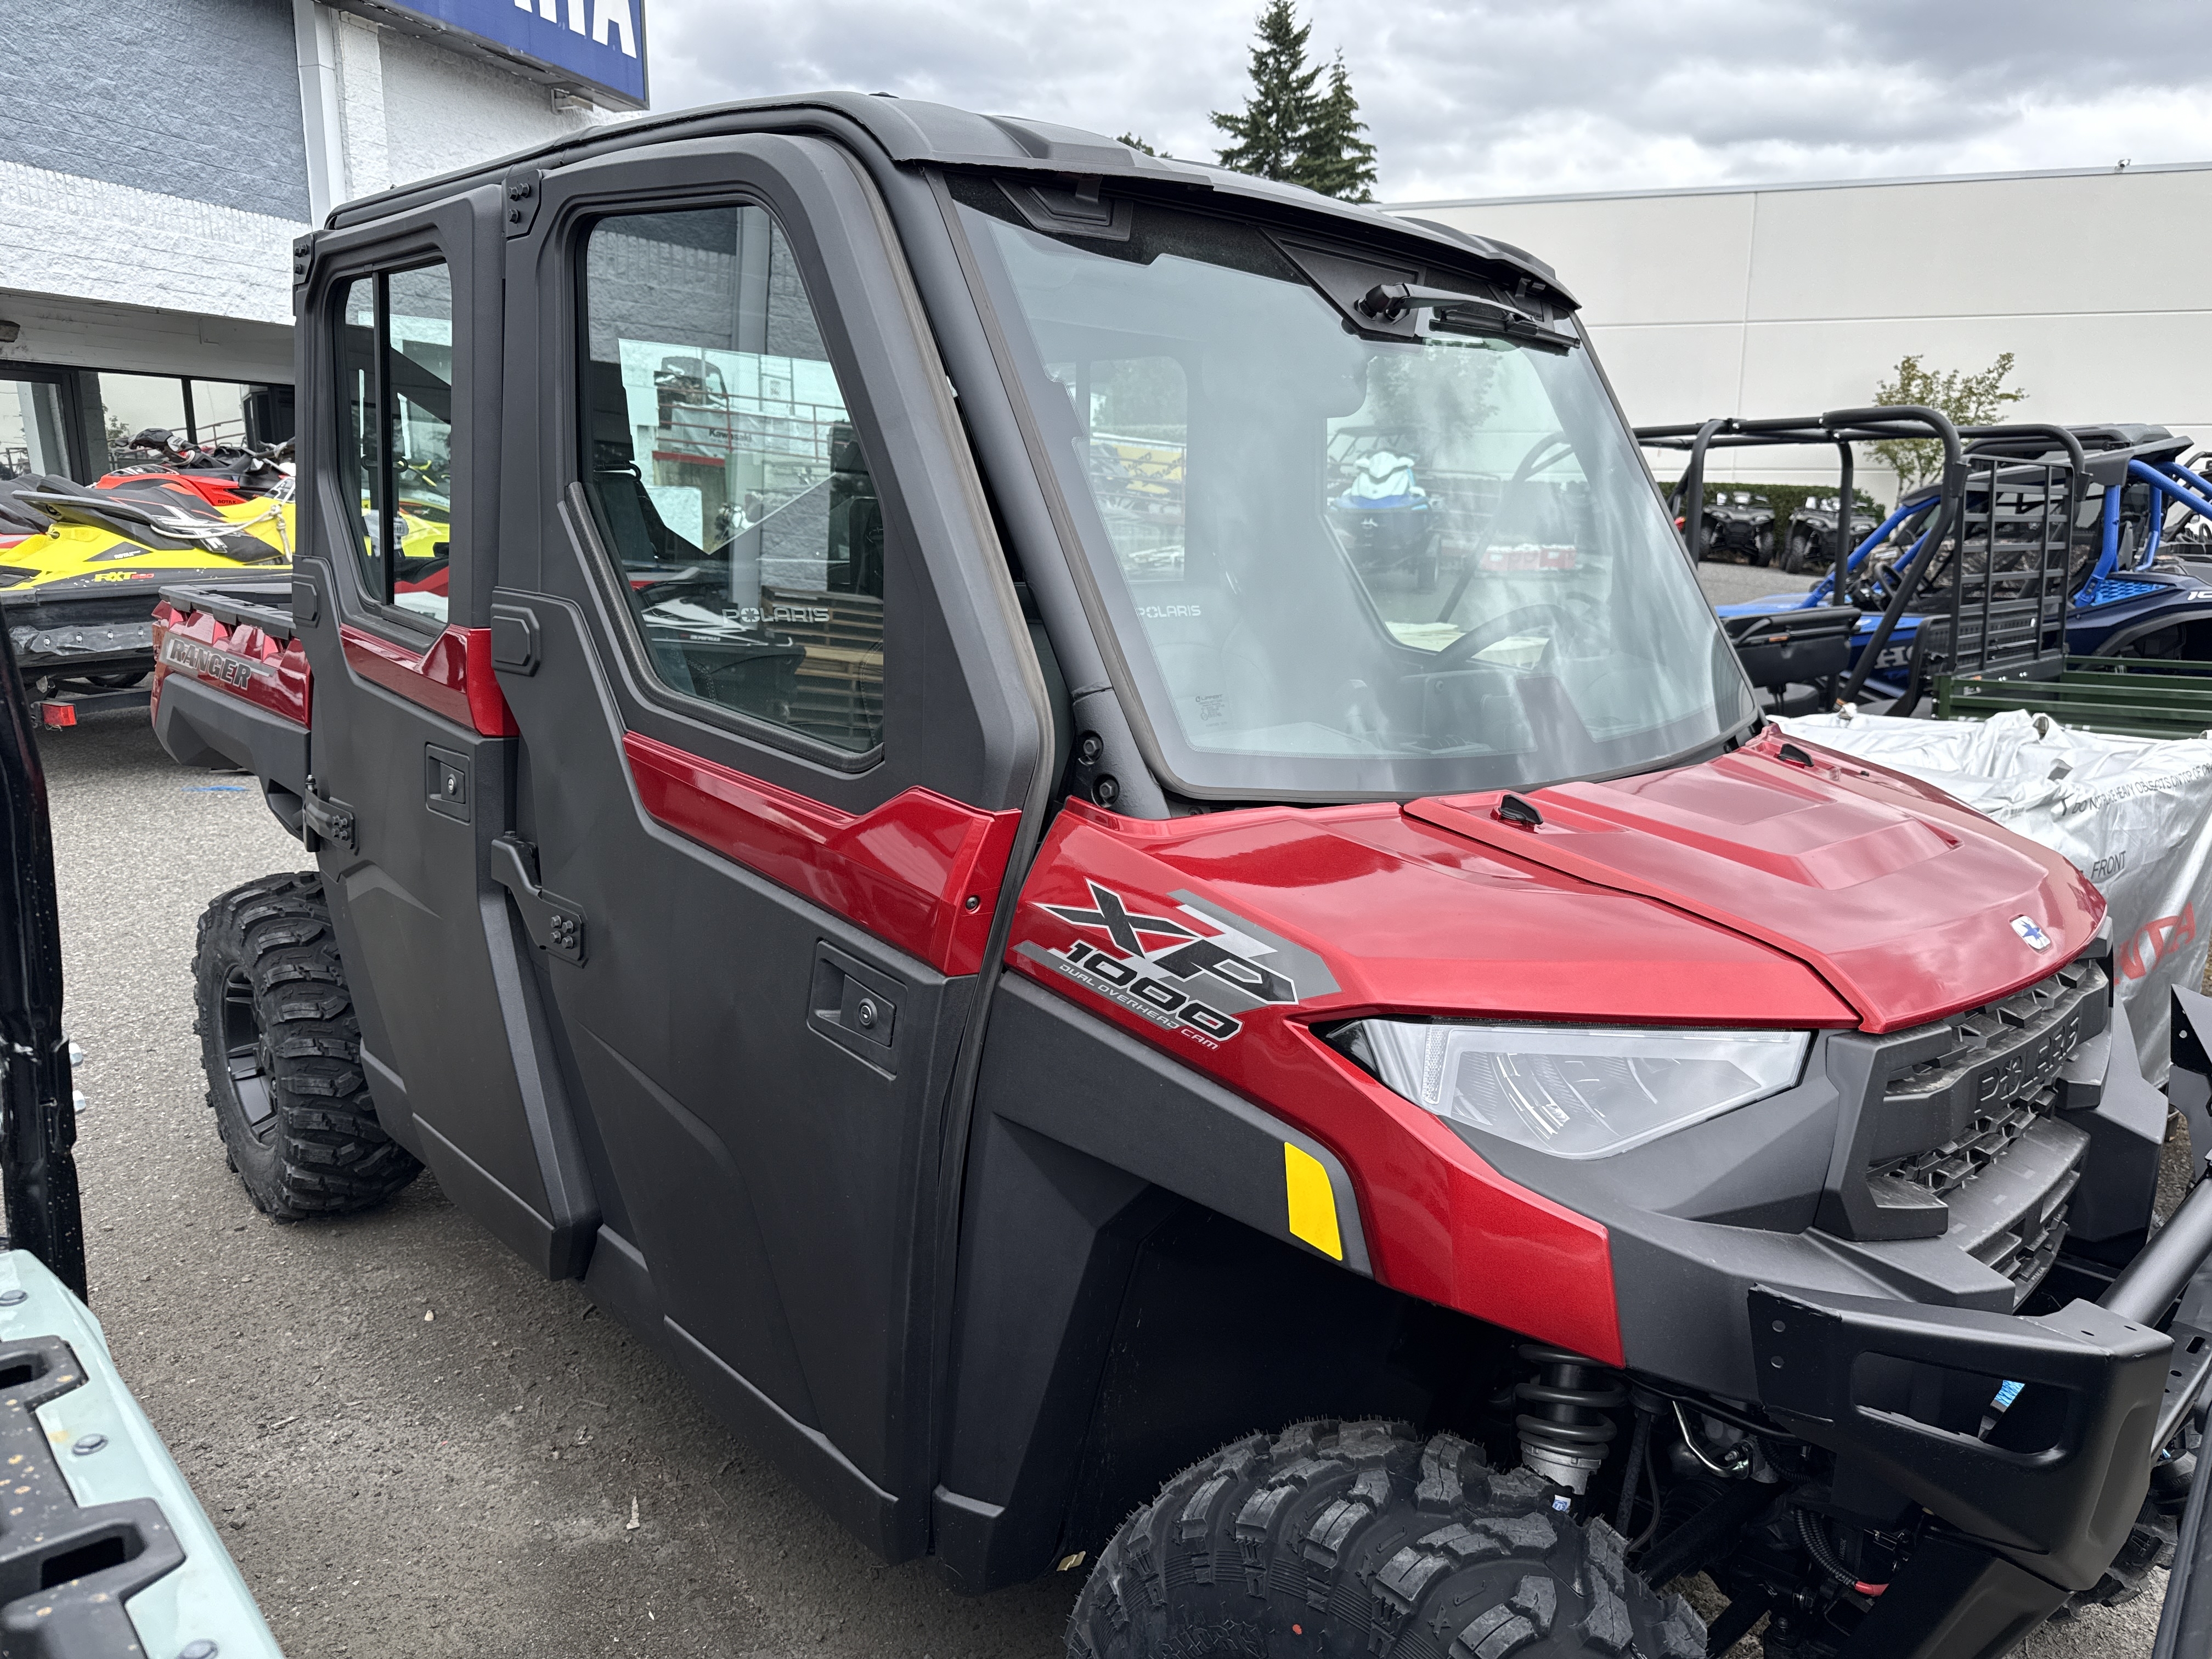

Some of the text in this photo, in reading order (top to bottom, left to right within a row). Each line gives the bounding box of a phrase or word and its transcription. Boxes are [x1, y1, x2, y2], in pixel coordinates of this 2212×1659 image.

[721, 607, 830, 624] POLARIS
[170, 638, 252, 690] RANGER
[2091, 850, 2126, 879] FRONT
[1027, 877, 1300, 1006] XP
[1059, 963, 1220, 1051] DUAL OVERHEAD CAM
[1064, 939, 1243, 1042] 1000
[1973, 1012, 2080, 1114] POLARIS
